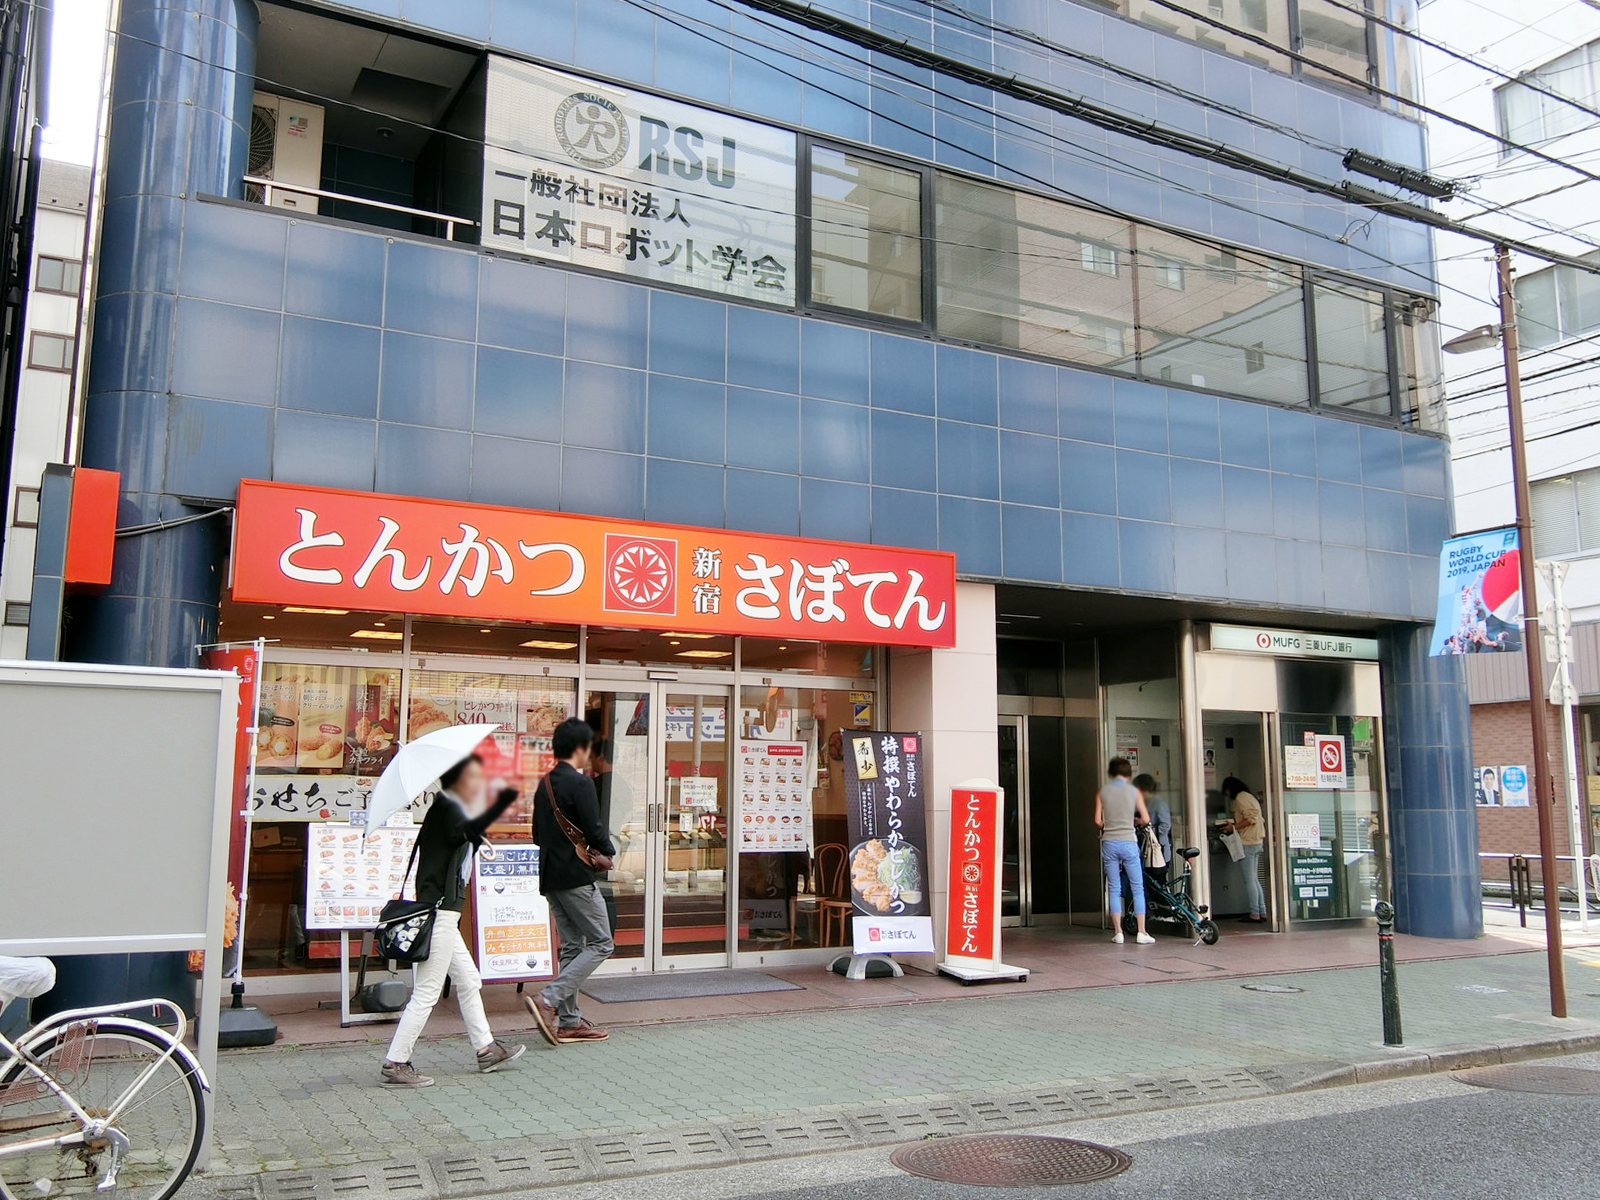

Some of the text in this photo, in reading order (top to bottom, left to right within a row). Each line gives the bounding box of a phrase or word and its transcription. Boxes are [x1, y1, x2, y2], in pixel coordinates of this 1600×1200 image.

[639, 115, 736, 189] RSJ
[494, 167, 692, 228] 一般社団法人
[492, 199, 788, 292] 日本ロボット学会
[277, 507, 586, 598] とんかつ
[691, 546, 721, 615] 新宿
[1449, 545, 1484, 559] RUGBY
[1449, 549, 1507, 568] WORLD CUP
[1471, 559, 1506, 572] JAPAN
[734, 552, 948, 632] さぼてん
[1273, 636, 1353, 653] MUFG 三菱UFJ銀行
[464, 700, 513, 713] ヒレかつ弁当
[906, 762, 917, 798] さぼてん
[880, 735, 906, 915] 特撰やわらかヒレかつ
[963, 793, 981, 862] とんかつ
[887, 930, 917, 940] さぼてん
[960, 892, 980, 953] さぼてん
